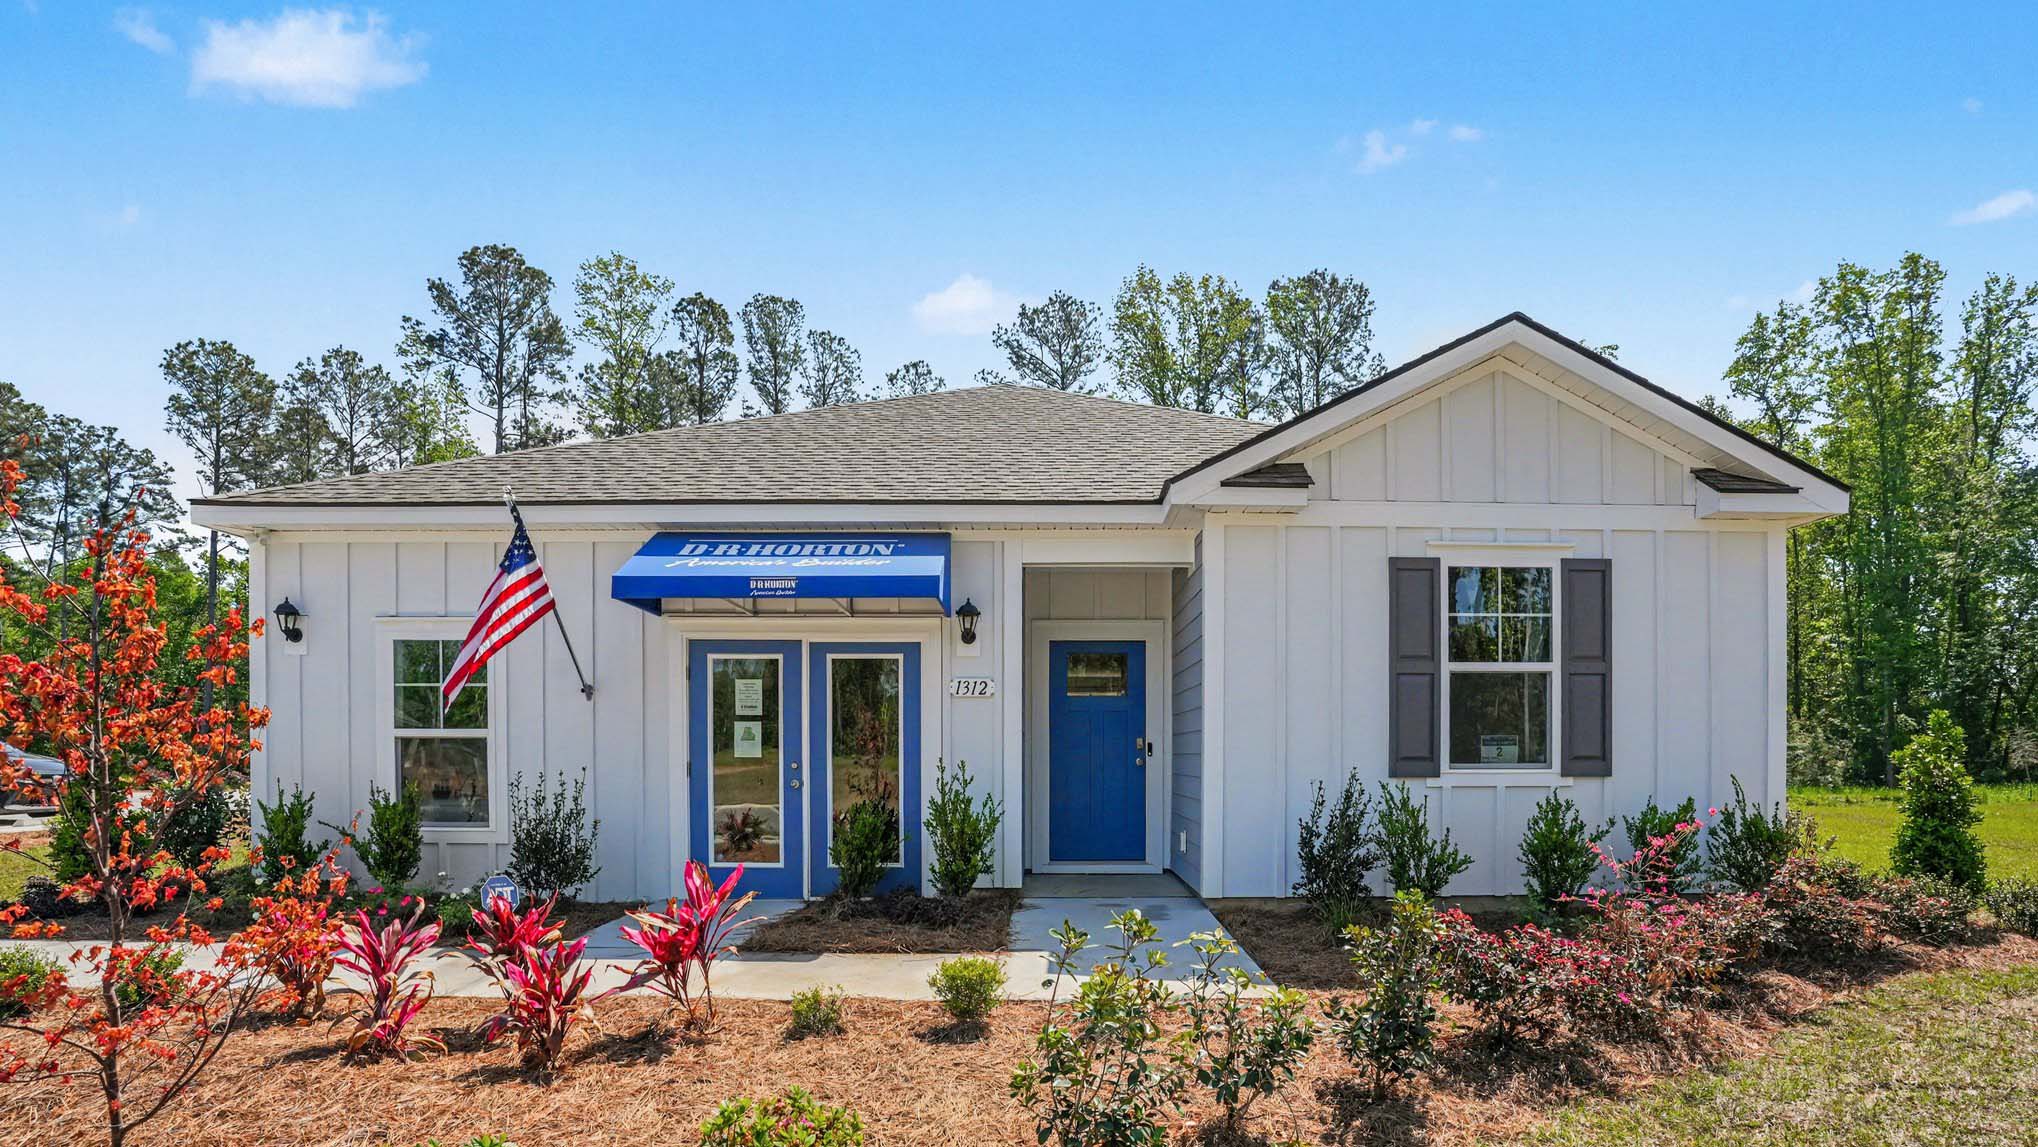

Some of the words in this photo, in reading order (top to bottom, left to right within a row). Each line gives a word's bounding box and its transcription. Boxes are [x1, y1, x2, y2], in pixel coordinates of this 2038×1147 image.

[665, 557, 787, 568] America's
[792, 558, 891, 567] Builder
[956, 680, 988, 695] 1312
[1496, 746, 1503, 757] 2
